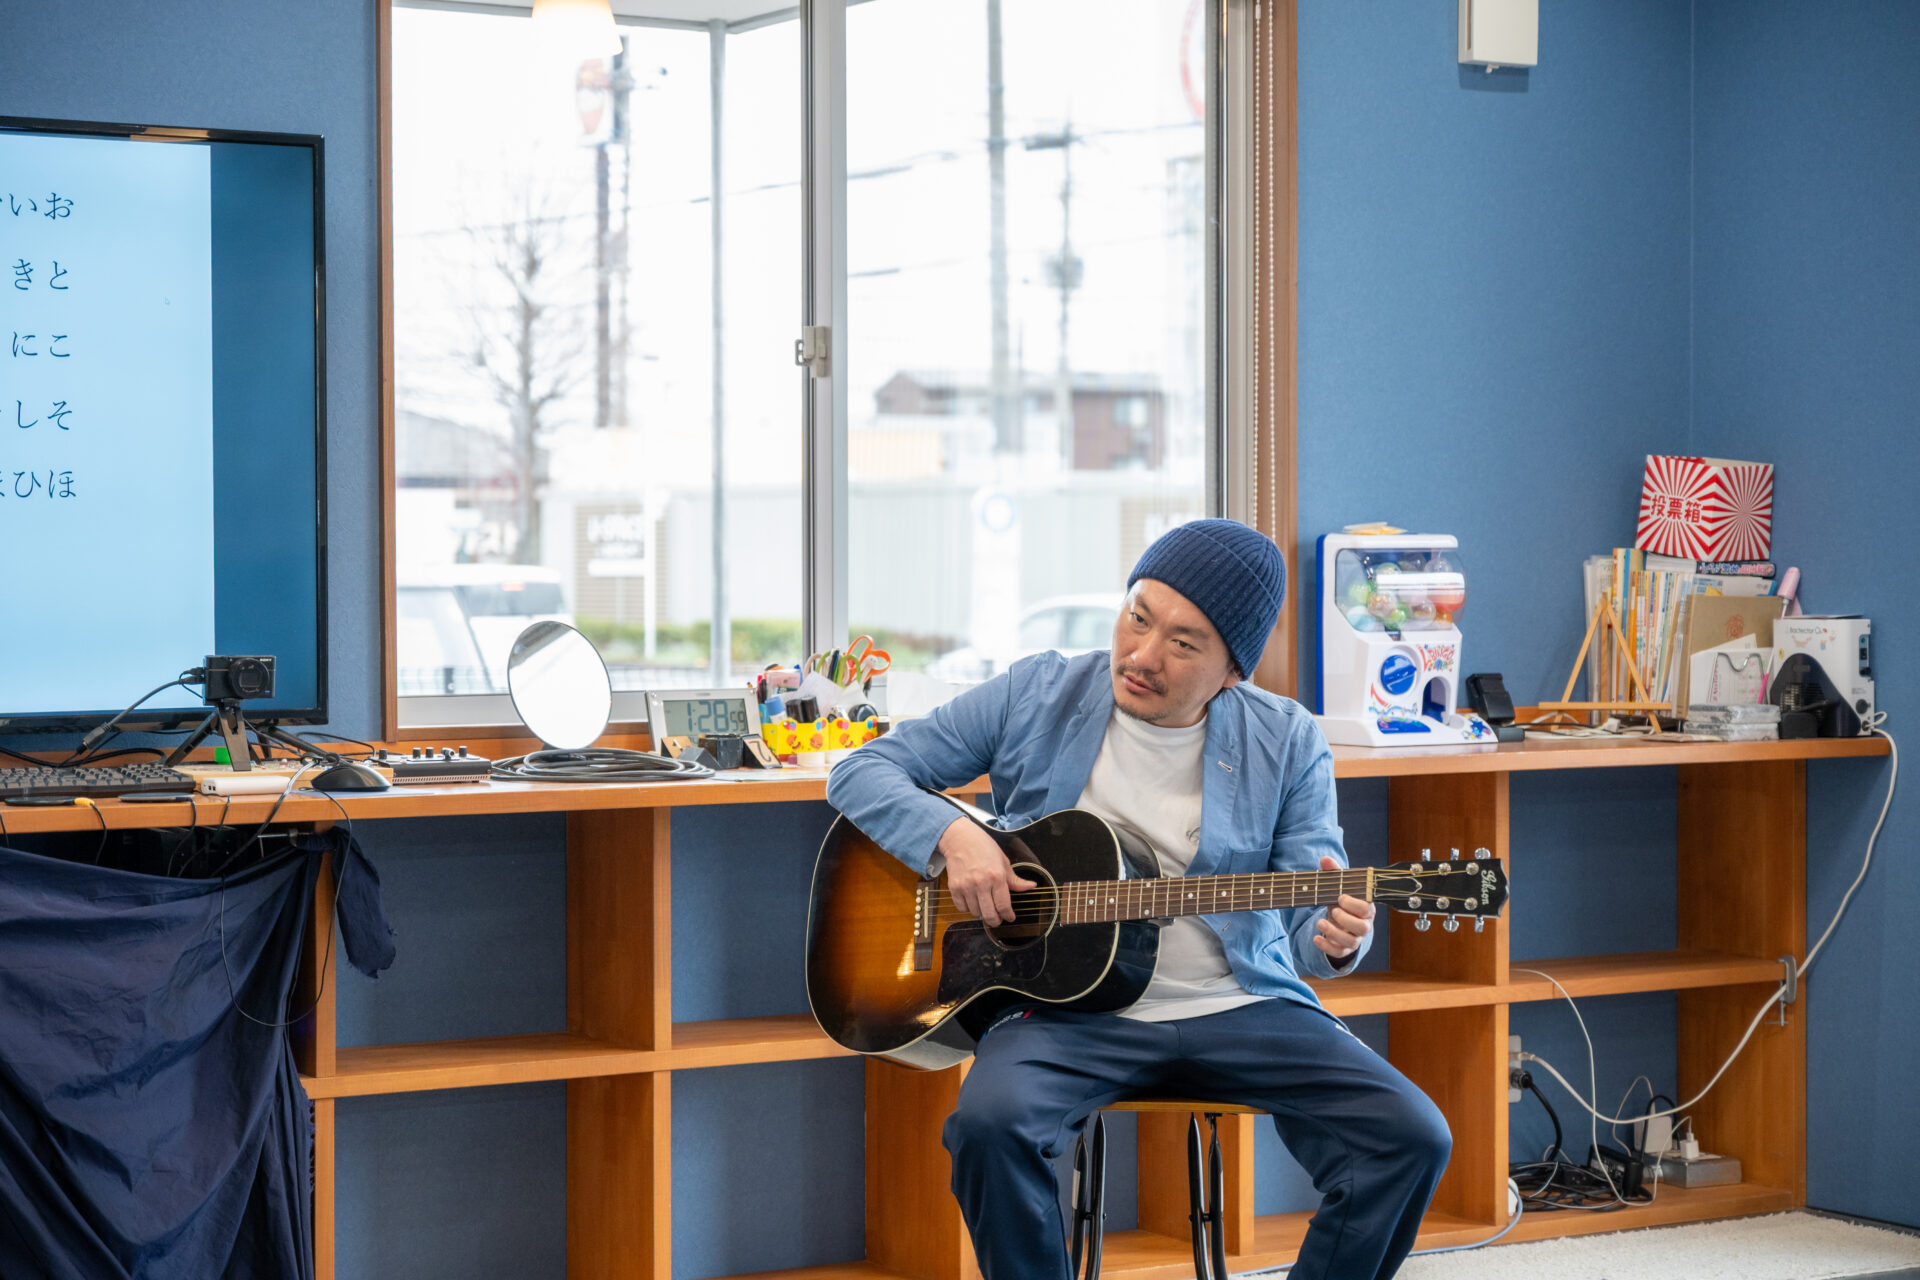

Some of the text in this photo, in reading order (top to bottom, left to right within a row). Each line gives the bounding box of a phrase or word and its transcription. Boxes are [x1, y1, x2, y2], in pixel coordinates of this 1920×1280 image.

[0, 192, 74, 220] いお
[0, 399, 73, 431] しそ
[0, 469, 76, 499] ひほ
[1651, 494, 1701, 523] 投票箱
[1481, 869, 1497, 906] Gibson
